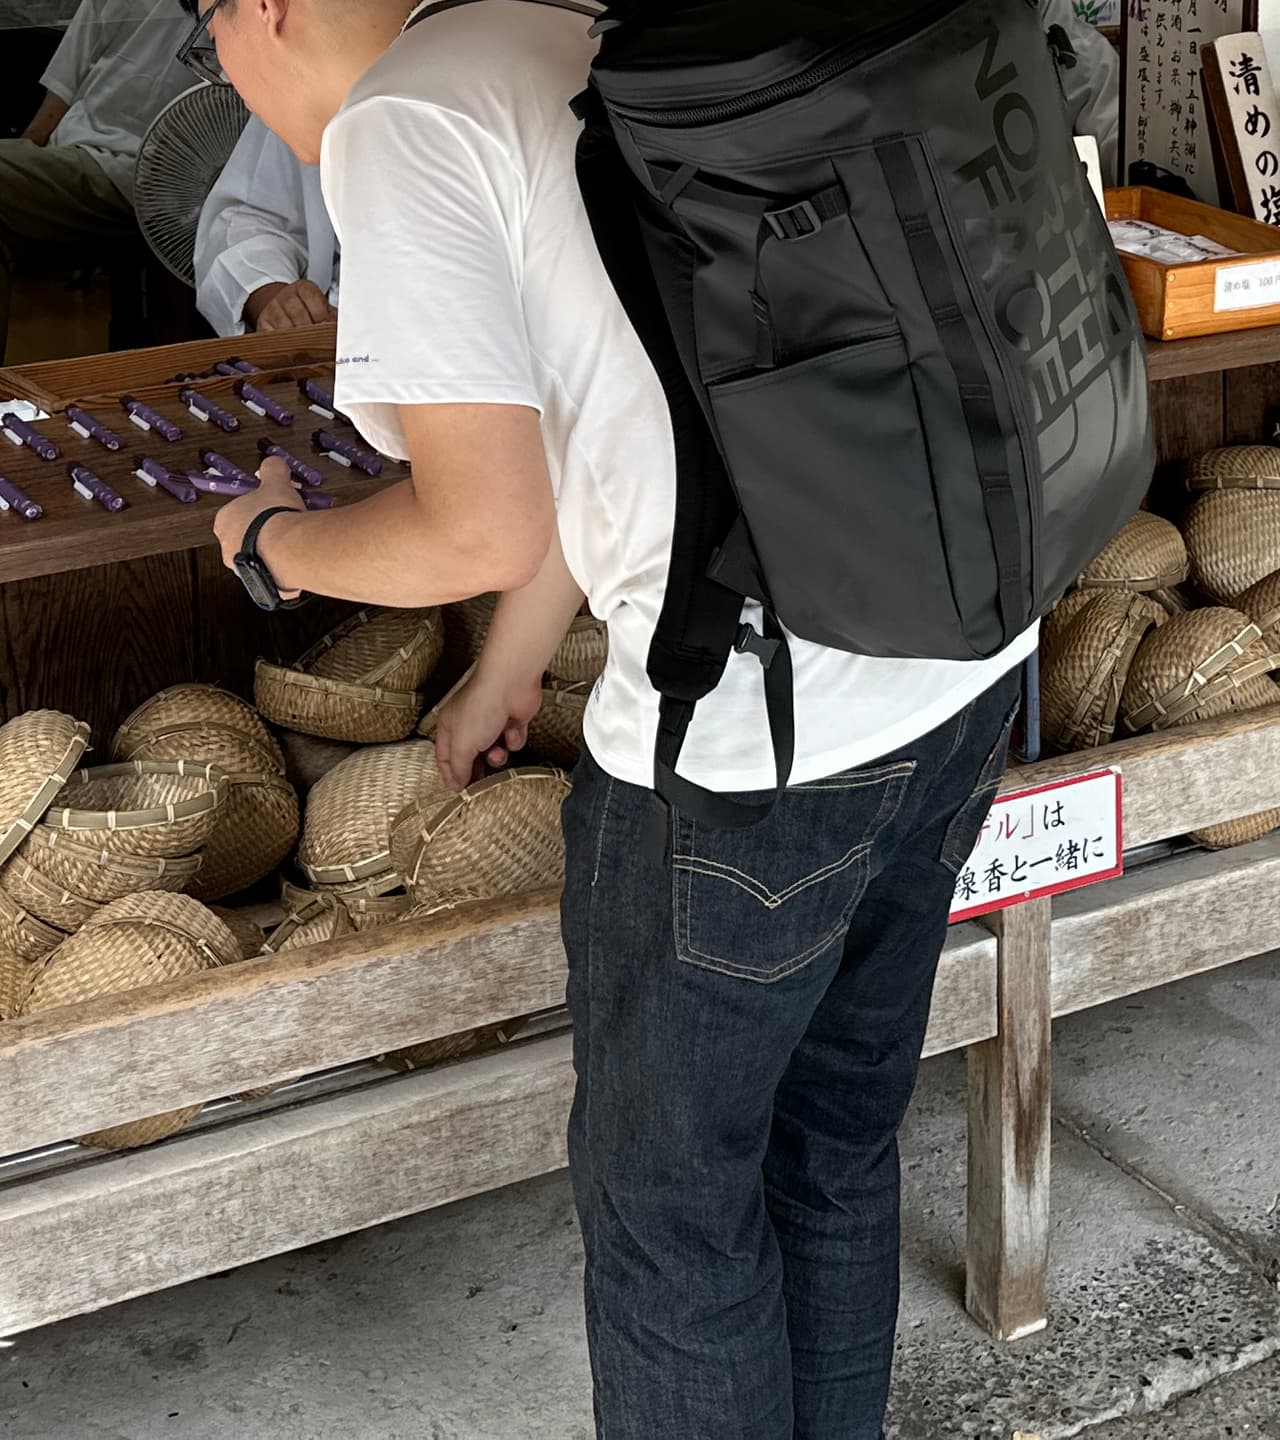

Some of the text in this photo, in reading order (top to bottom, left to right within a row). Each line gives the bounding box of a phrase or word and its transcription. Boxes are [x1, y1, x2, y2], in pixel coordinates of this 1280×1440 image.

[952, 836, 1104, 901] 線香と一緒に
